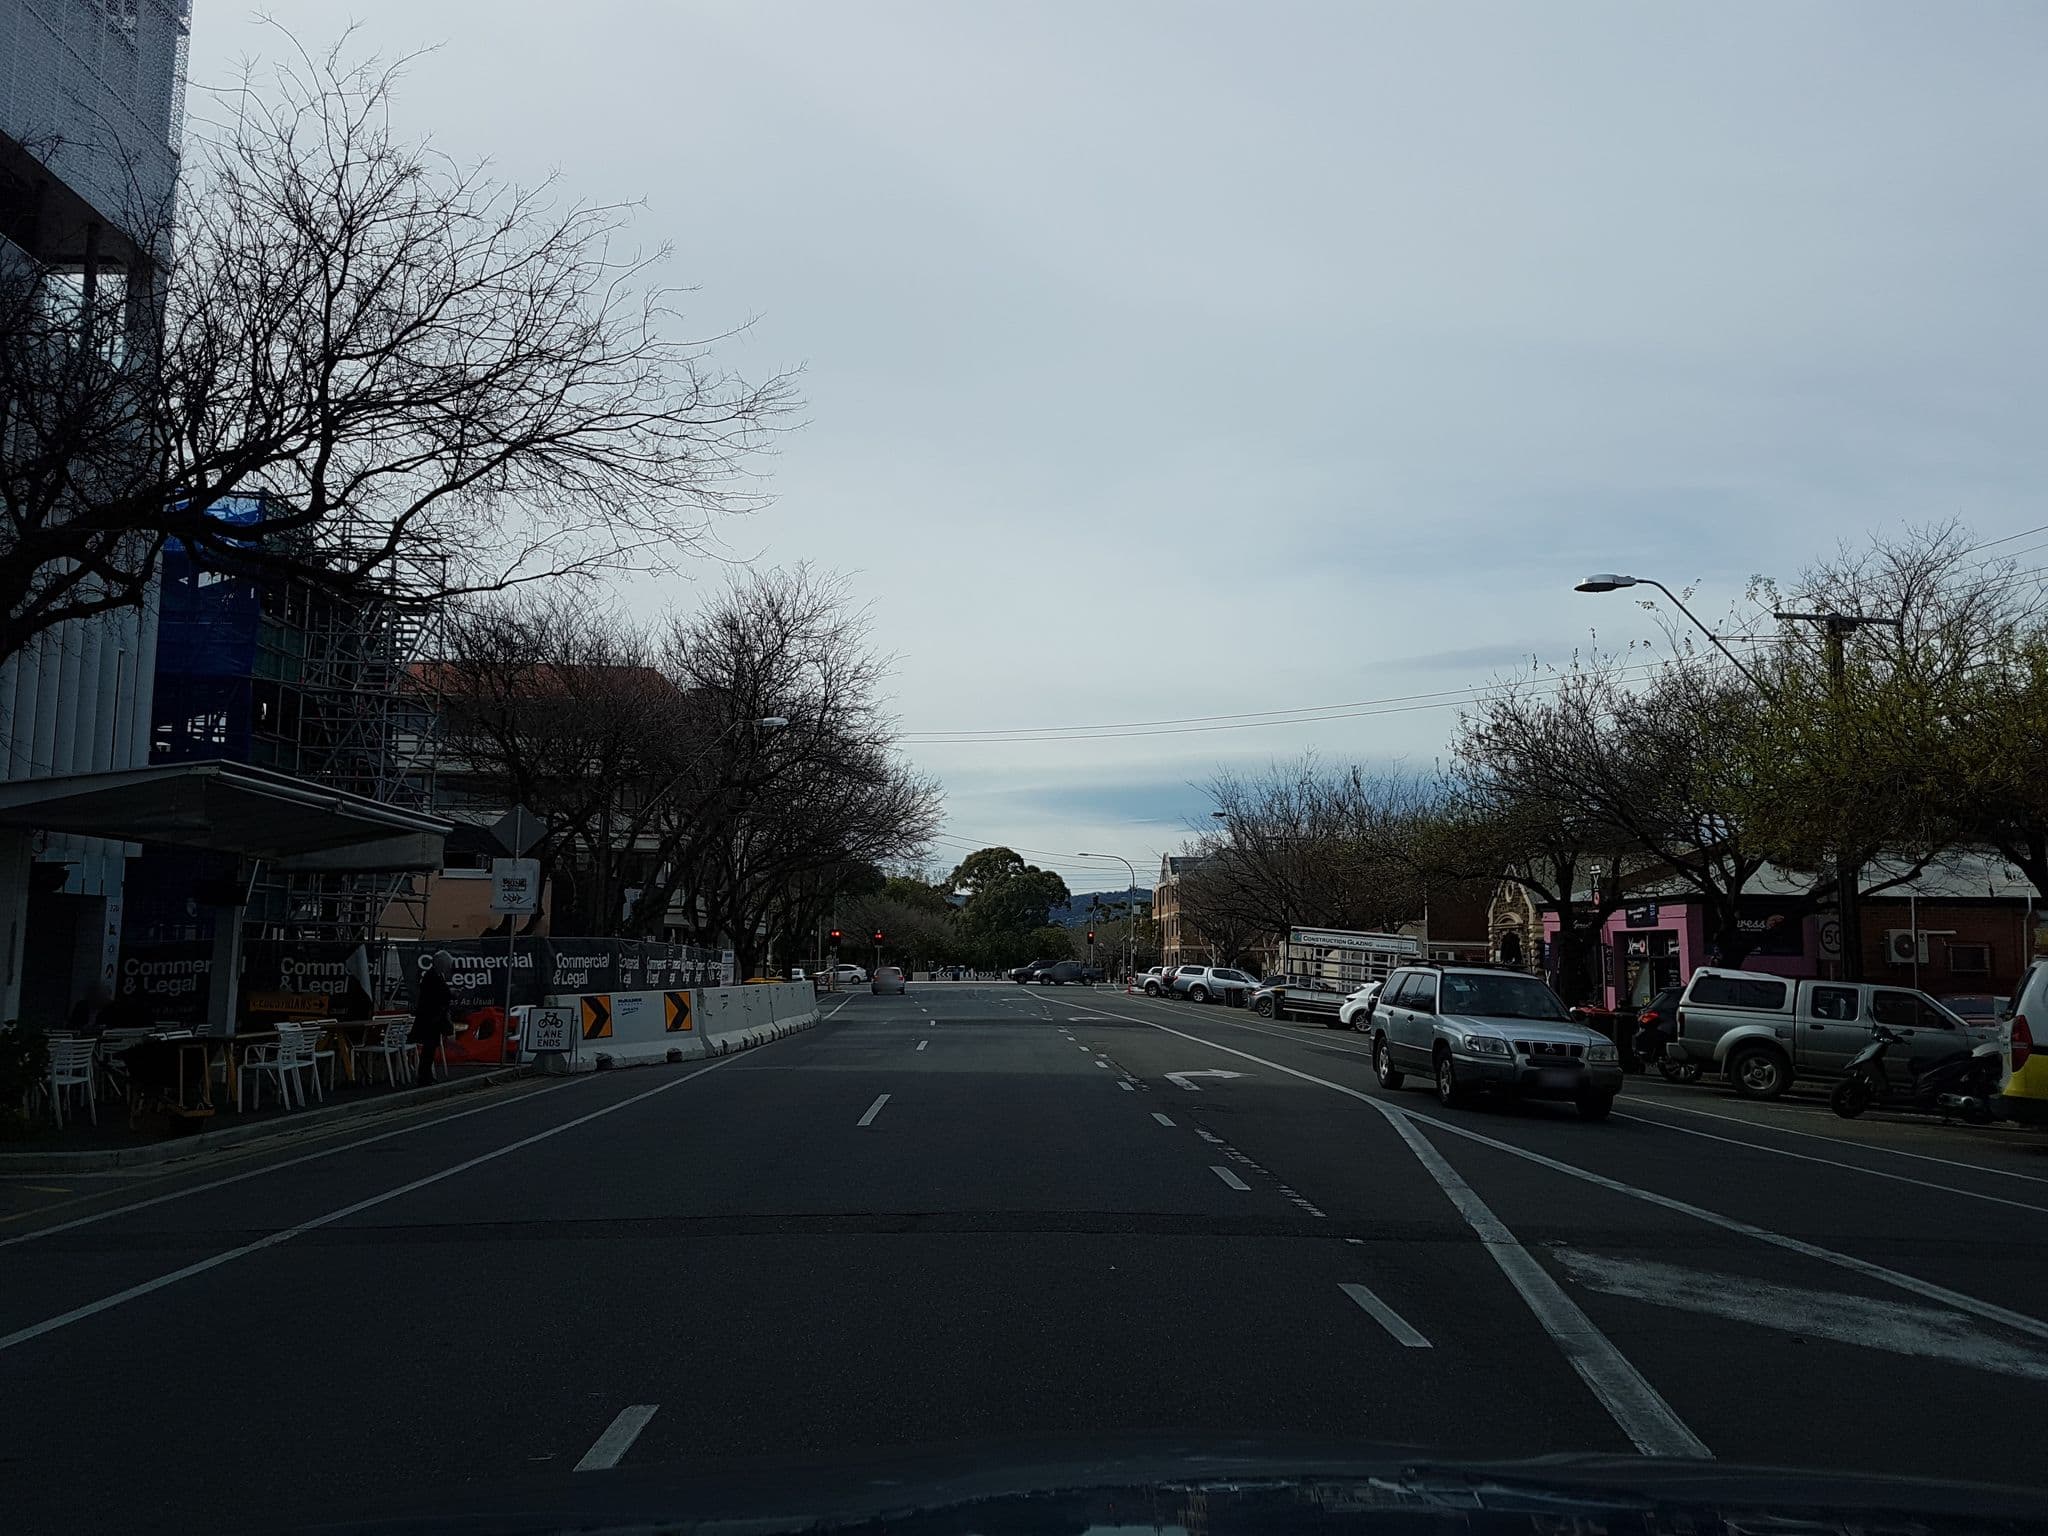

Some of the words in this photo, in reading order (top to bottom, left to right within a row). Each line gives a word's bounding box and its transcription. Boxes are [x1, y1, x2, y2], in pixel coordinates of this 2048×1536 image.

[417, 952, 534, 970] Cmmercial
[123, 977, 137, 995] &
[143, 974, 198, 997] Legal
[565, 970, 589, 989] Legal
[537, 1030, 563, 1039] LANE
[537, 1039, 561, 1048] ENDS
